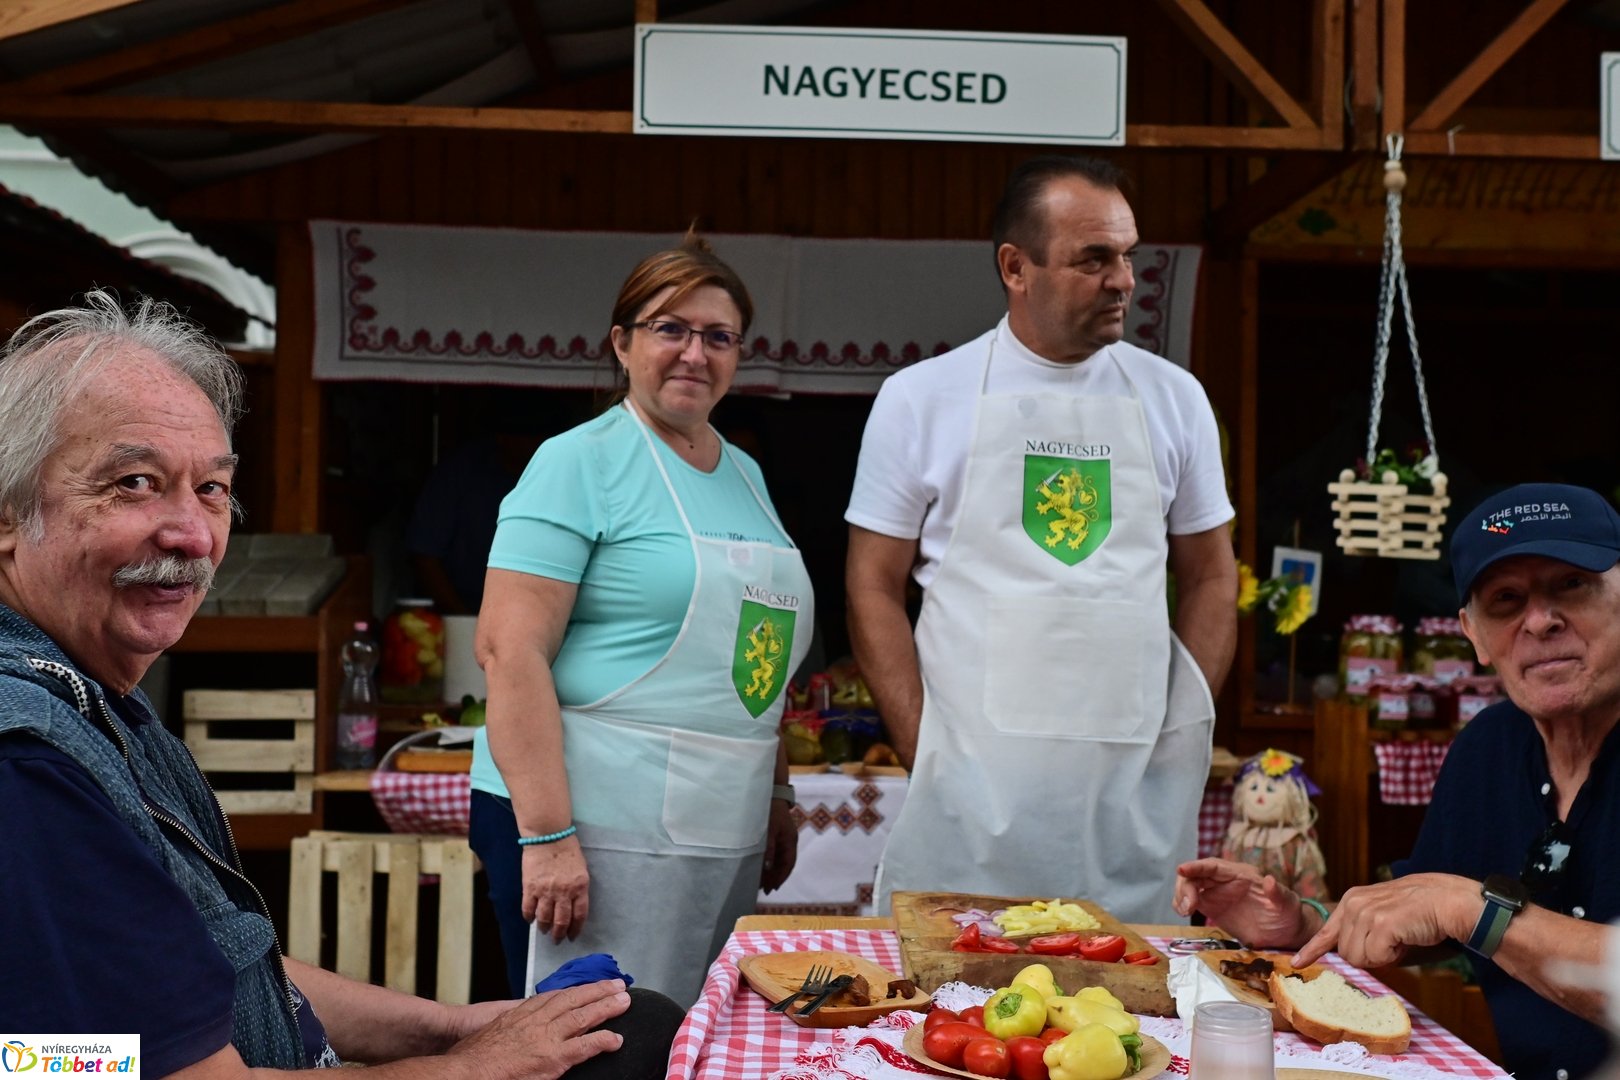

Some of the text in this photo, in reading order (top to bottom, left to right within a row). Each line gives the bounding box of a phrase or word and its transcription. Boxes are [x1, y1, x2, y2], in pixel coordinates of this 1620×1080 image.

[762, 64, 1008, 105] NAGYECSED
[1025, 440, 1111, 457] NAGYECSED
[1489, 502, 1569, 523] THE RED SEA
